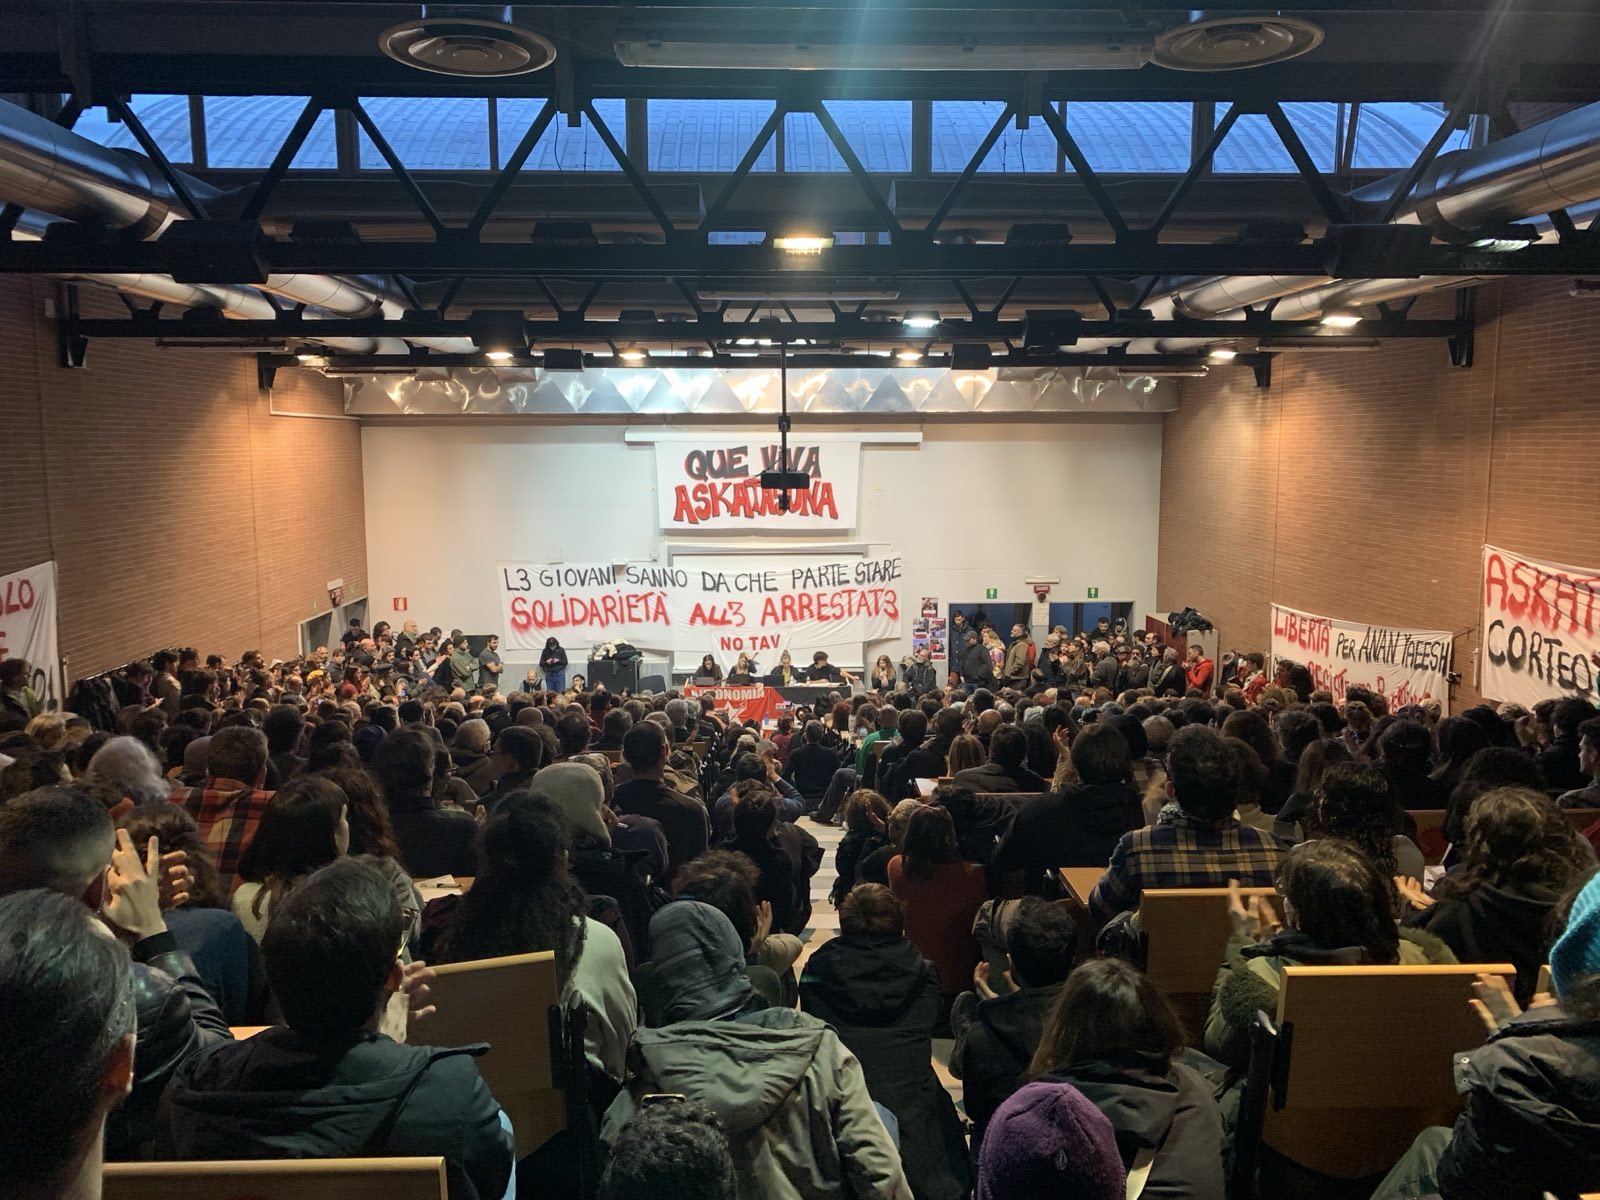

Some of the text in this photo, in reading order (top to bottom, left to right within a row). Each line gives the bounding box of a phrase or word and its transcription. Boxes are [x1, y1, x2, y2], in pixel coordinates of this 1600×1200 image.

[684, 445, 749, 482] QUE
[673, 479, 839, 525] ASKATAUNA
[503, 557, 901, 593] L3 GIOVANI SANNO DA CHE PARTE STARE
[0, 579, 34, 615] LO
[689, 601, 746, 627] ALL3
[760, 588, 900, 627] ARRESTAT3
[1486, 554, 1600, 639] ASKAT
[720, 634, 780, 651] NO TAV
[1335, 632, 1356, 663] PER
[1358, 626, 1400, 664] ANAN
[1487, 619, 1594, 698] CORTEO
